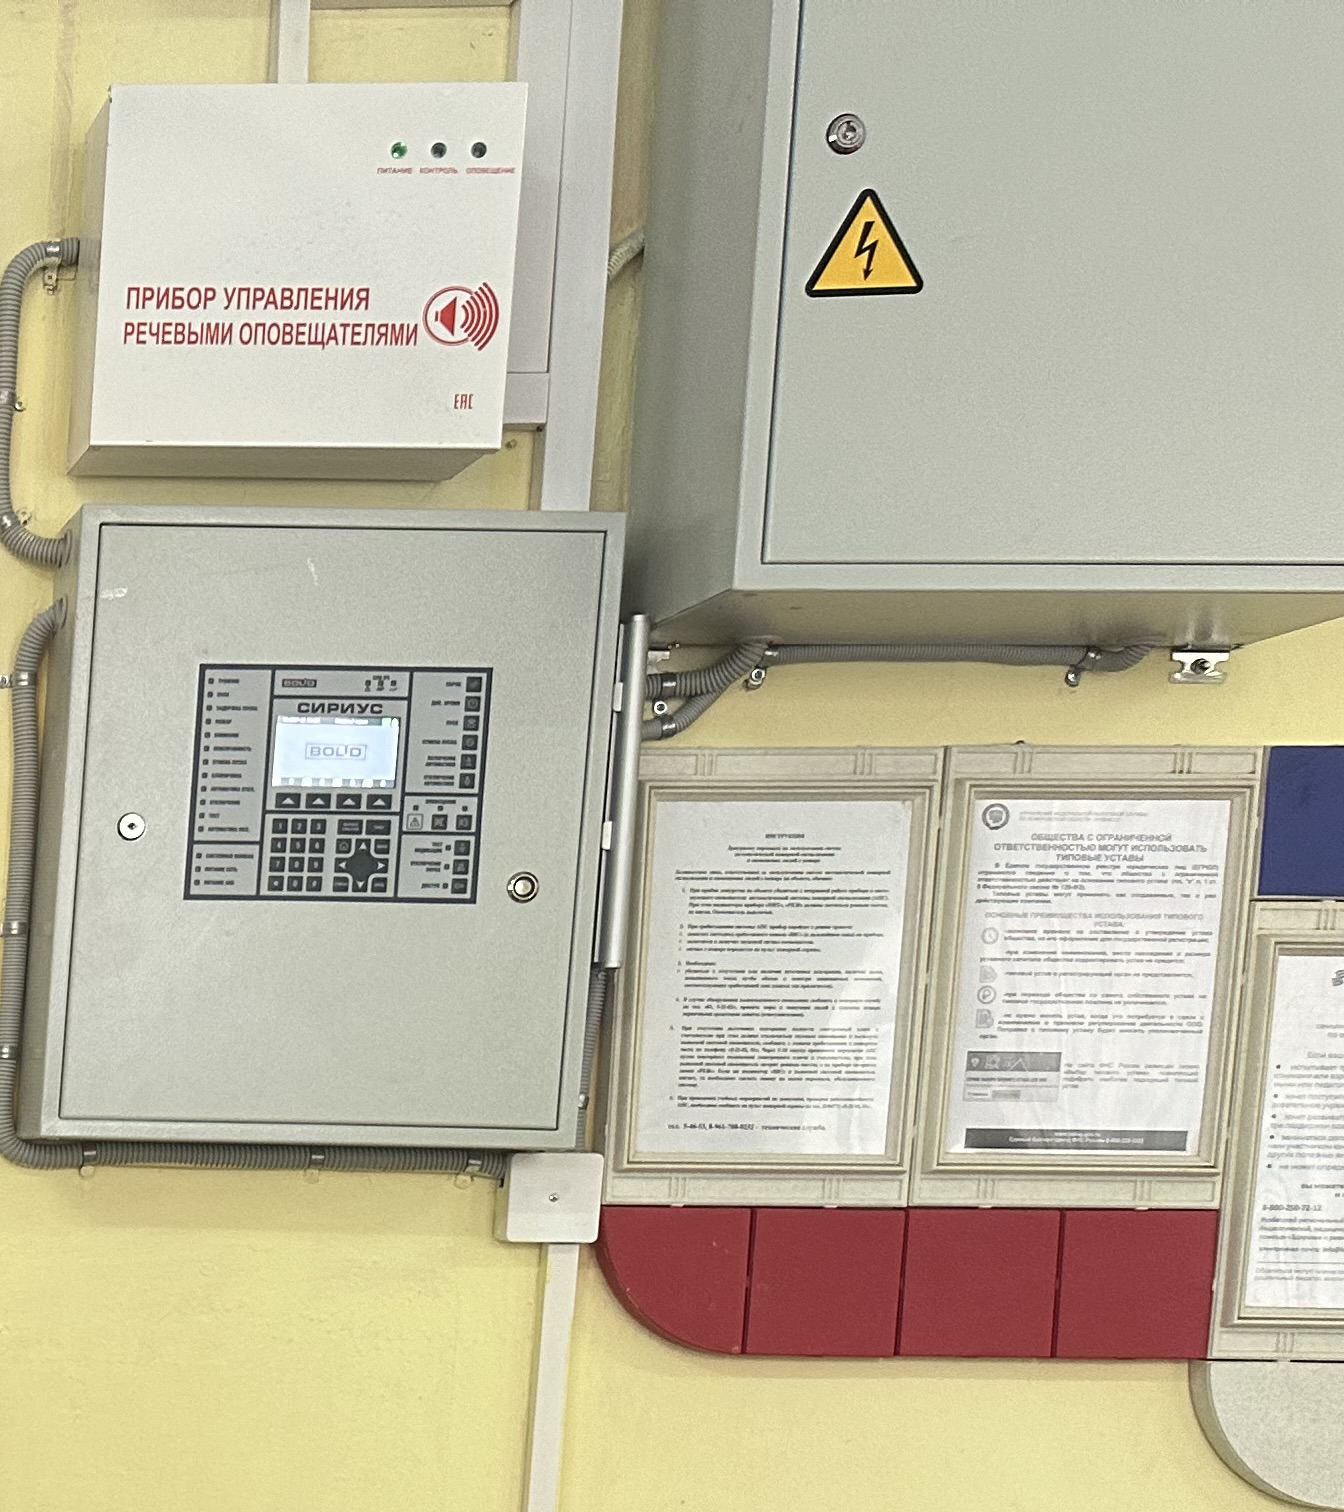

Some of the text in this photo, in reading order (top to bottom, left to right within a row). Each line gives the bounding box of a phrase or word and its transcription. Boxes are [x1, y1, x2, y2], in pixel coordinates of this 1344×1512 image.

[125, 286, 370, 311] ПРИБОР УПРАВЛЕНИЯ
[123, 321, 419, 350] РЕЧЕВЫМИ ОПОВЕЩАТЕЛЯМИ
[297, 702, 384, 715] СИРИУС
[310, 744, 363, 758] BOLID
[1031, 833, 1084, 842] ОБЩЕСТВА
[993, 843, 1208, 853] ОТВЕТСТВЕННОСТЬЮ МОГУТ ИСПОЛЬЗОВАТЬ
[1056, 854, 1144, 863] ТИПОВЫЕ УСТАВЫ
